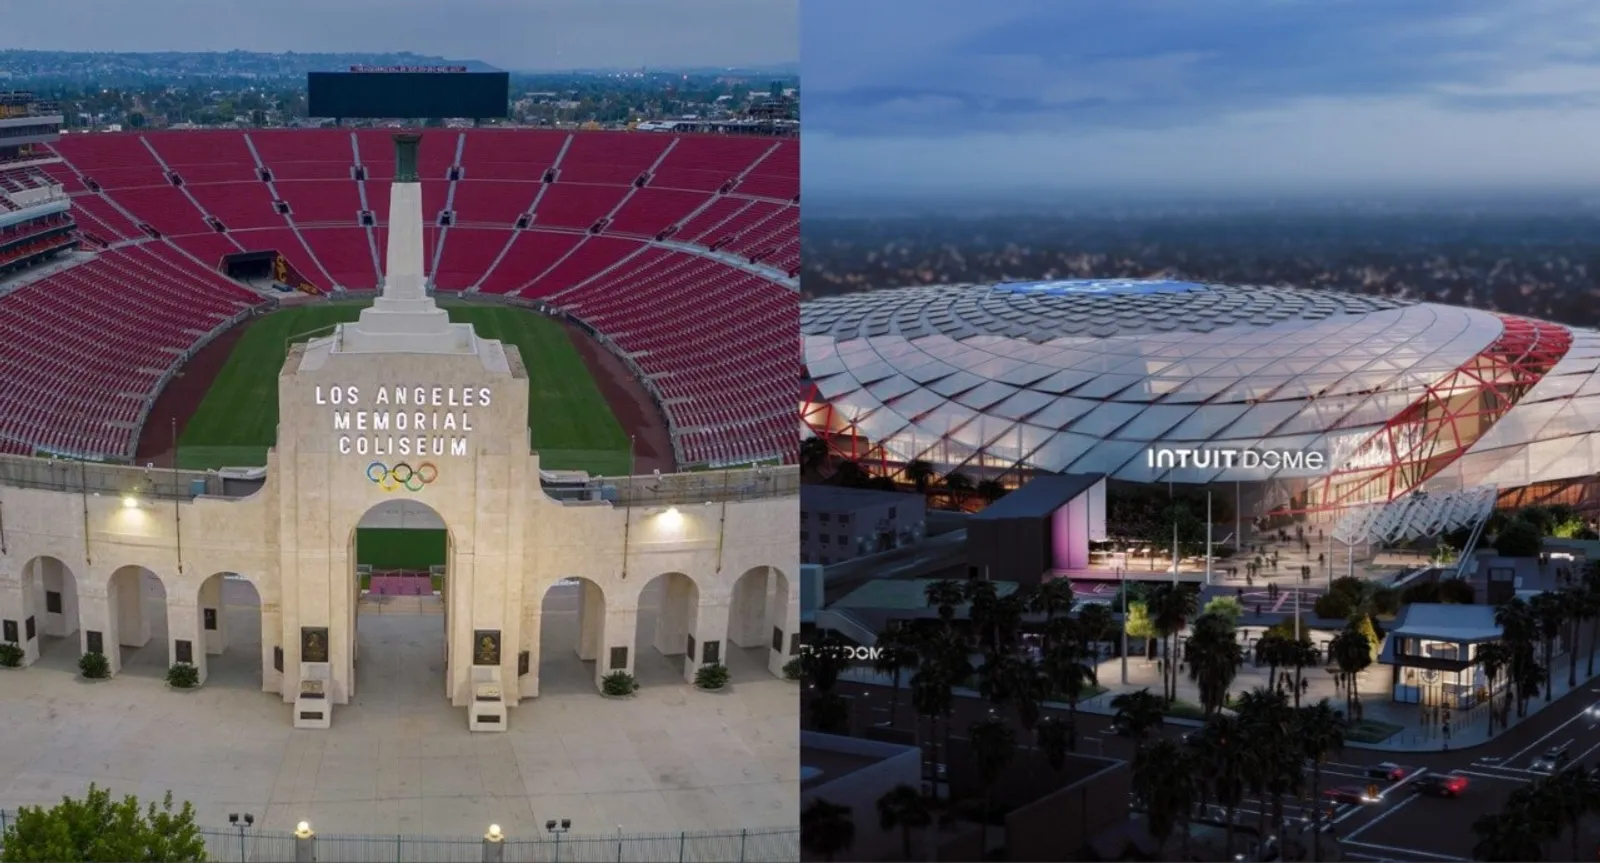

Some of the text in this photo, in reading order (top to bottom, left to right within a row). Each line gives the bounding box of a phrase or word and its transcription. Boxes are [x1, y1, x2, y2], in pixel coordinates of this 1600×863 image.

[315, 386, 491, 406] LOS ANGELES
[334, 411, 473, 431] MEMORIAL
[339, 436, 467, 455] COLISEUM
[843, 645, 892, 660] DOM
